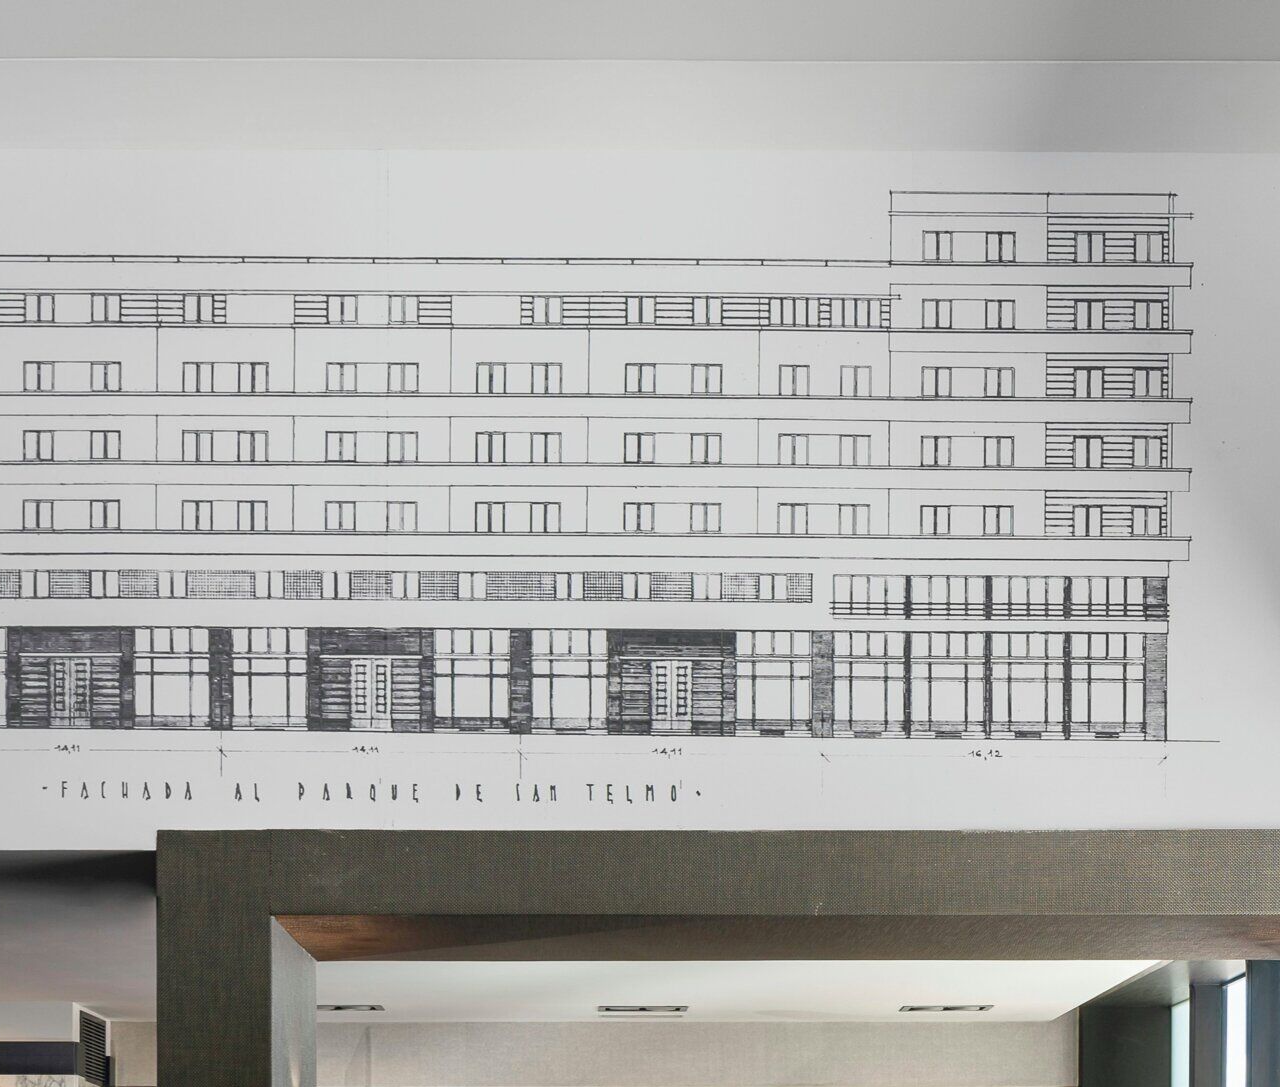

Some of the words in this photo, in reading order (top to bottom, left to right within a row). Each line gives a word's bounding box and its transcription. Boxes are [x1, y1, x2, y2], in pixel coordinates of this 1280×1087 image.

[967, 749, 1003, 761] 16,12
[234, 782, 260, 802] AL
[297, 782, 418, 803] PARQUE
[455, 784, 483, 803] DE
